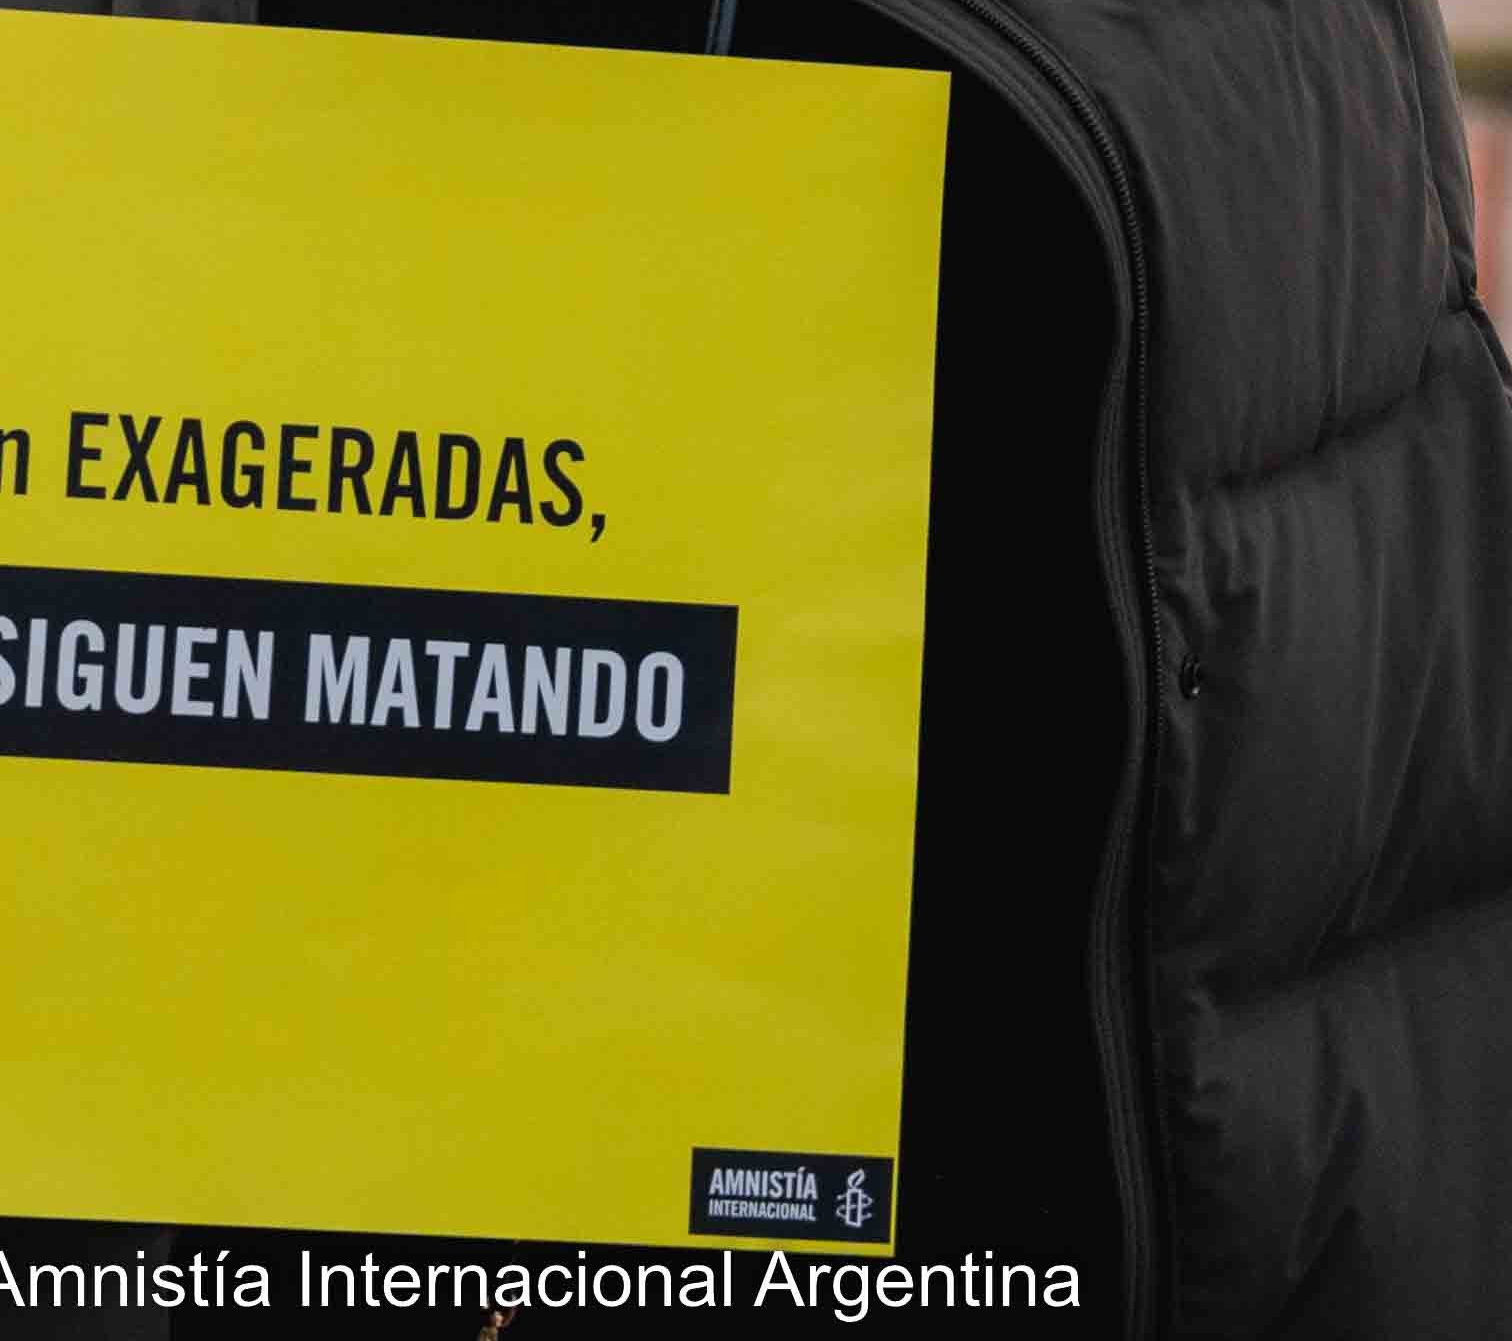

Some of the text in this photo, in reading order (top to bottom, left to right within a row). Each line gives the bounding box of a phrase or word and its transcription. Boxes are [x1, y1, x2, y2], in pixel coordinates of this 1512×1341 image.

[65, 411, 608, 541] EXAGERADAS,
[305, 633, 686, 744] MATANDO
[708, 1165, 819, 1200] AMNISTÍA
[708, 1199, 817, 1222] INTERNACIONAL
